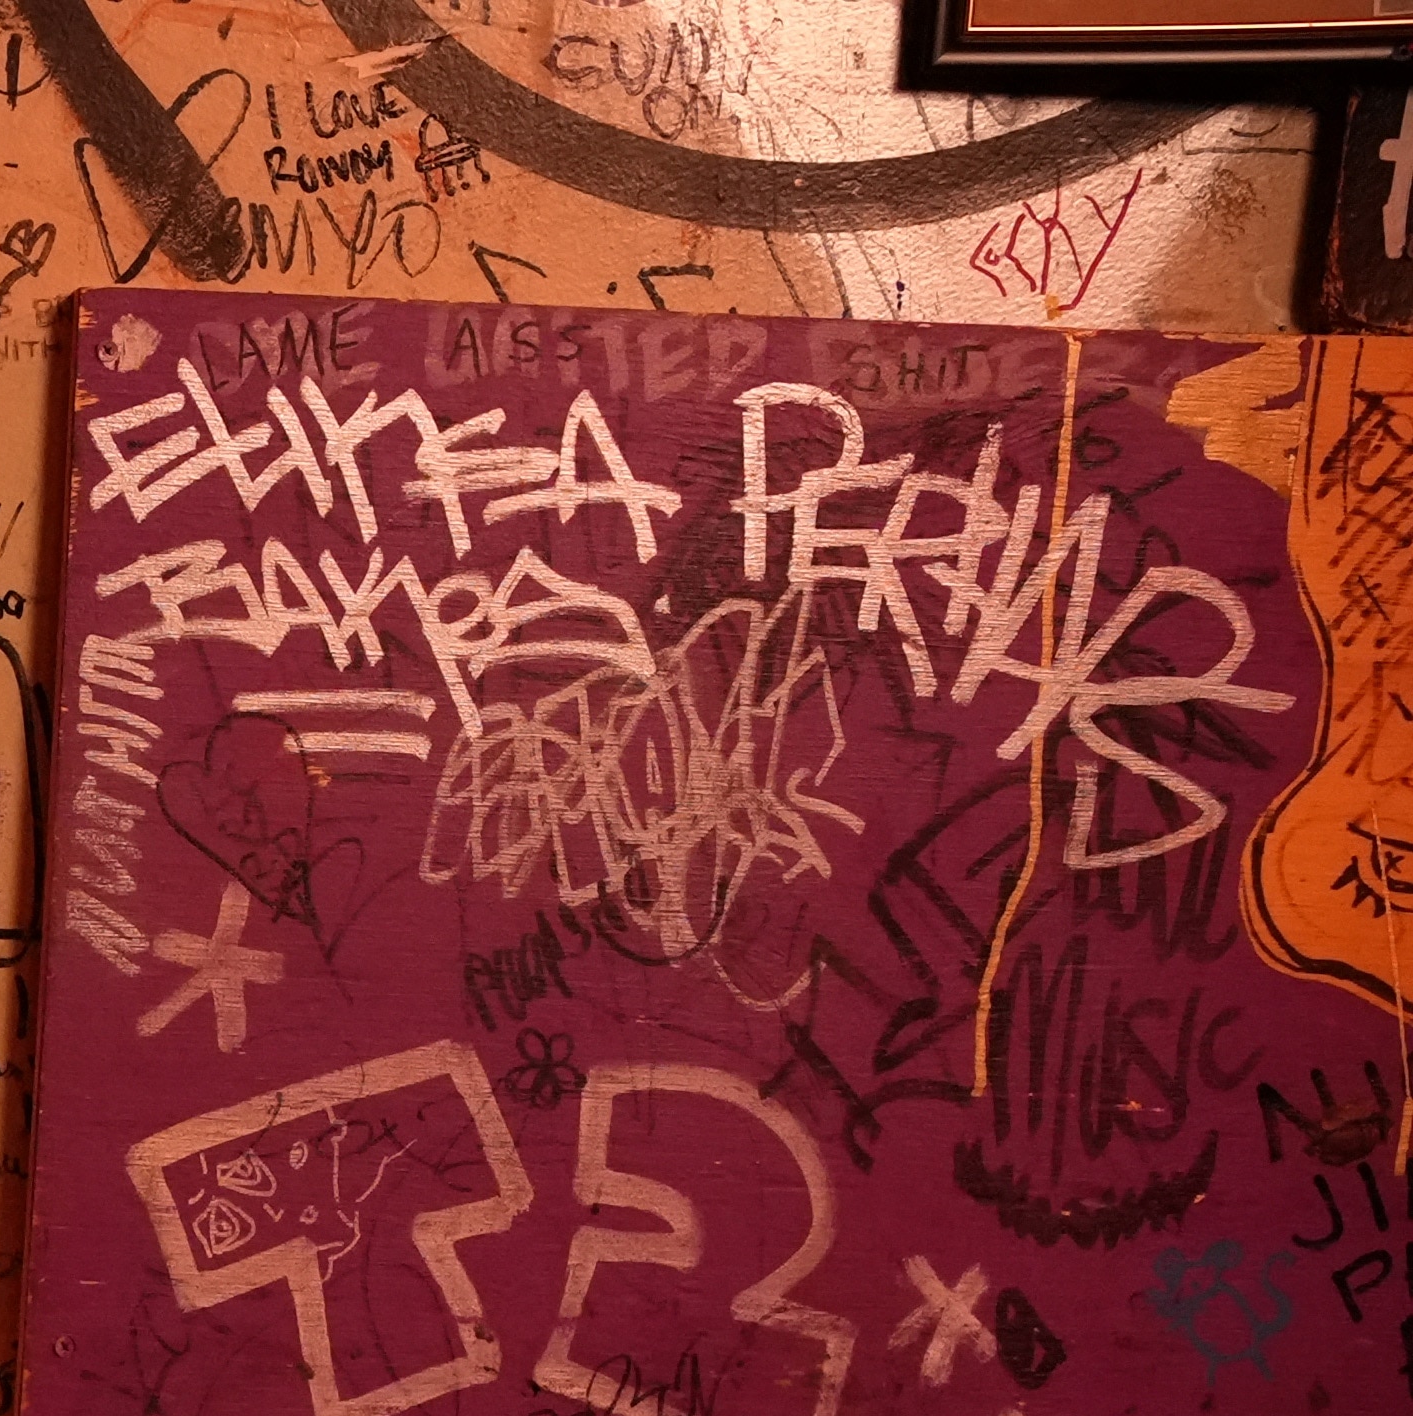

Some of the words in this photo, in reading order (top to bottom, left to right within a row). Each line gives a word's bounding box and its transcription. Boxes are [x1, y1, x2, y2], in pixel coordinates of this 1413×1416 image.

[195, 303, 365, 393] LAME
[444, 316, 593, 379] ASS
[841, 342, 991, 393] SHIT
